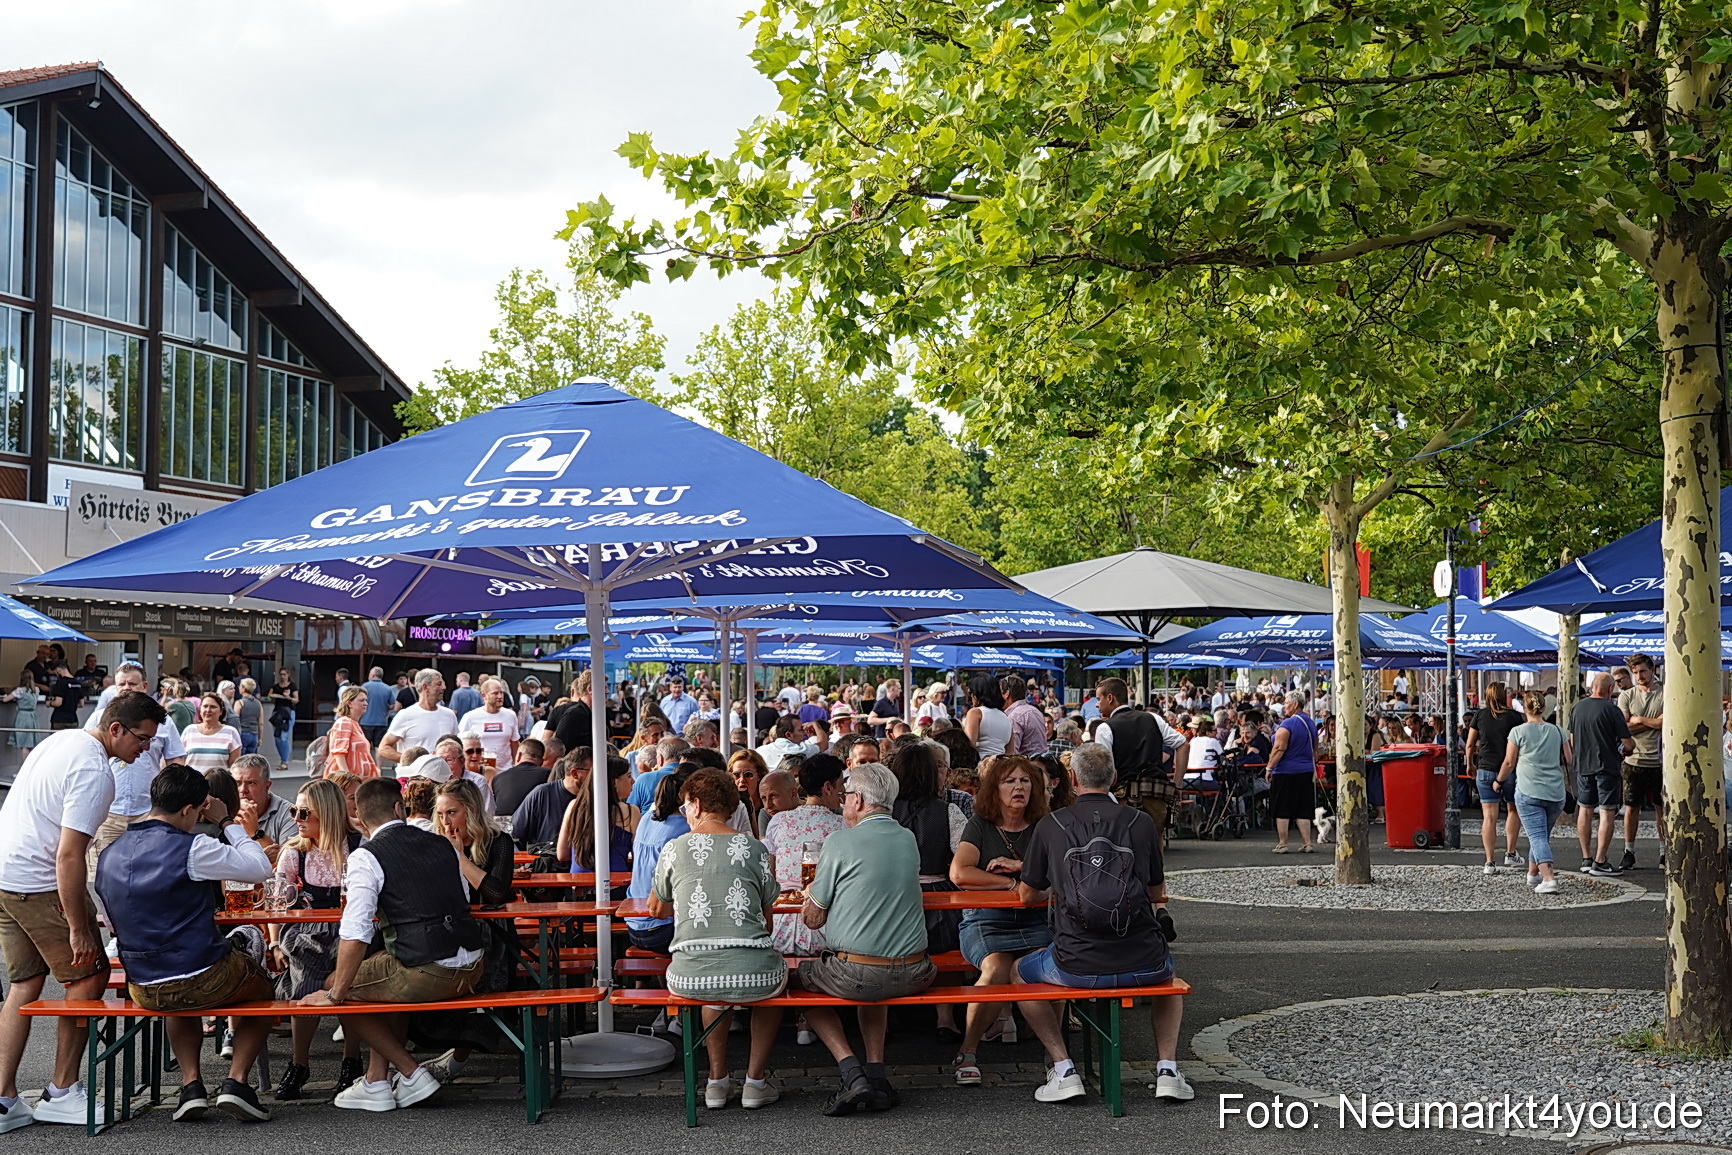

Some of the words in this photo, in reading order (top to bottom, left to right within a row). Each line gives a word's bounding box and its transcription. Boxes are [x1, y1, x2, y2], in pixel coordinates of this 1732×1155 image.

[78, 492, 150, 525] Härteis
[310, 486, 691, 529] GANSBRÄU
[204, 518, 453, 561] Neumarkt's
[457, 514, 573, 535] guter
[565, 509, 748, 531] Schluck
[48, 605, 82, 619] Currywurst
[255, 618, 283, 635] KASSE
[1218, 629, 1328, 640] GANSBRÄU
